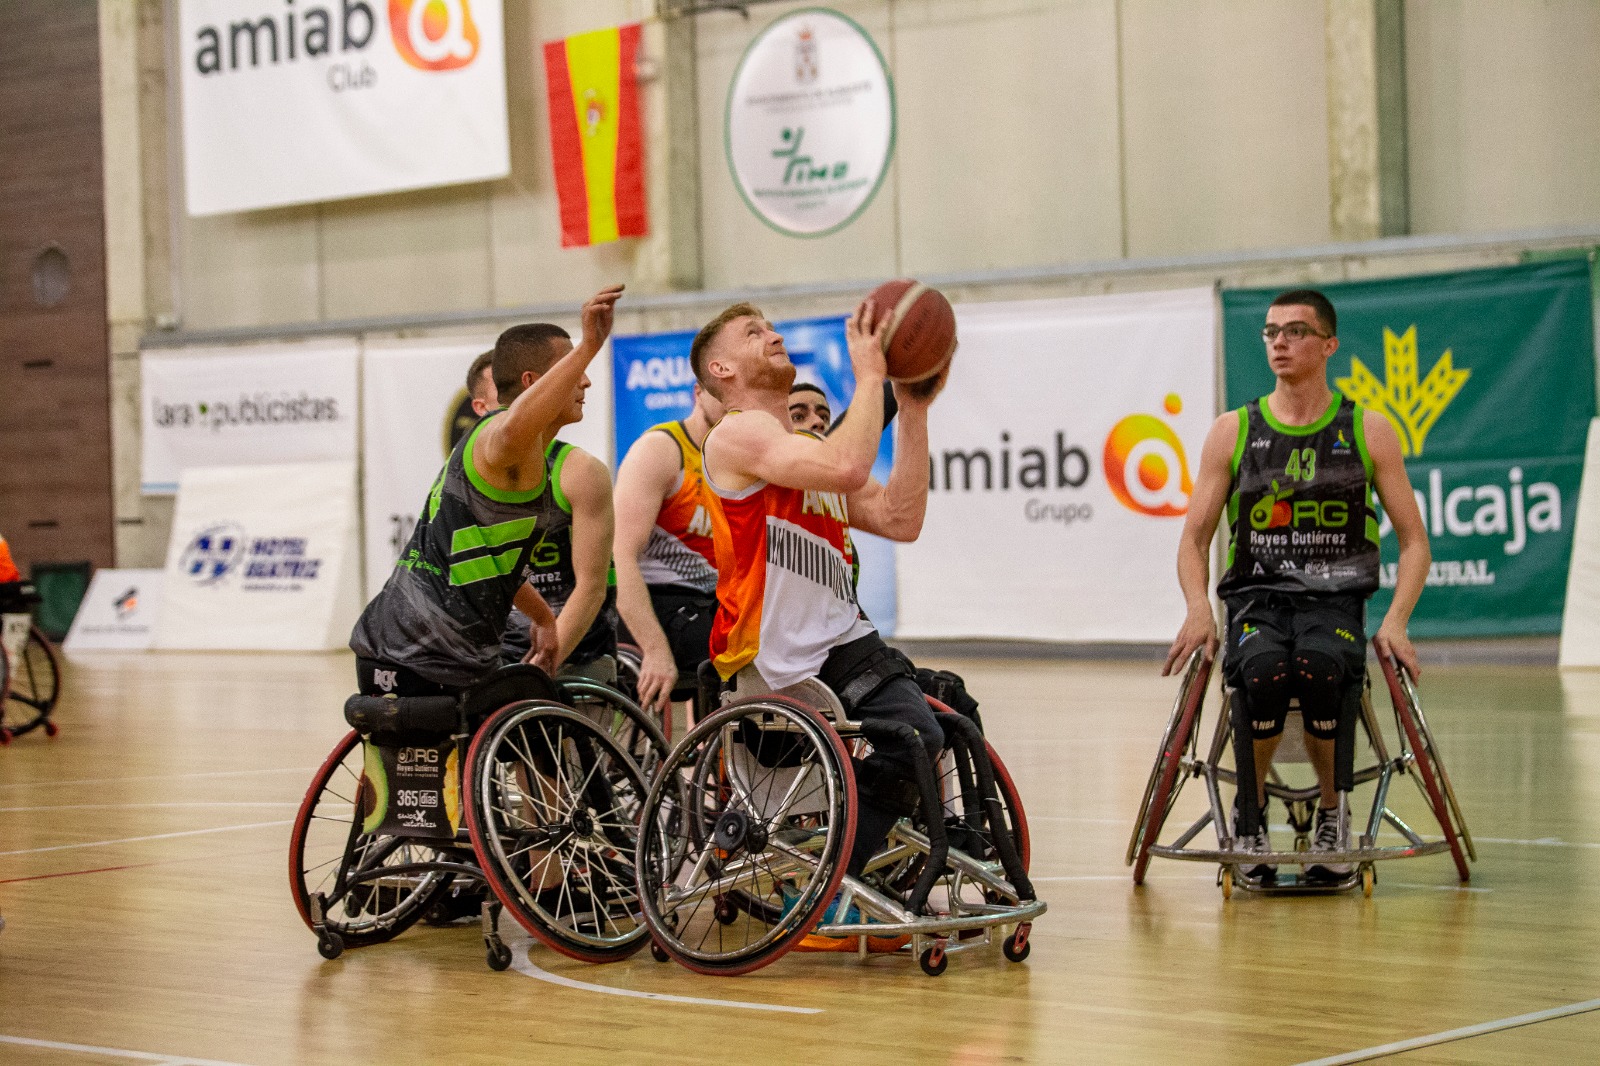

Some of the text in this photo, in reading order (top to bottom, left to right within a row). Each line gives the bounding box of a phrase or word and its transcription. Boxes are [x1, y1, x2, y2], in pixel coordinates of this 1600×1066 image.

[196, 0, 376, 74] amiab
[327, 62, 378, 92] Club
[929, 430, 1089, 491] miab
[1285, 448, 1317, 481] 43
[1025, 499, 1093, 526] Grupo
[1293, 500, 1349, 528] RG
[1250, 530, 1347, 547] Reyes Gutiérrez
[1425, 559, 1496, 586] URAL
[397, 790, 418, 807] 365
